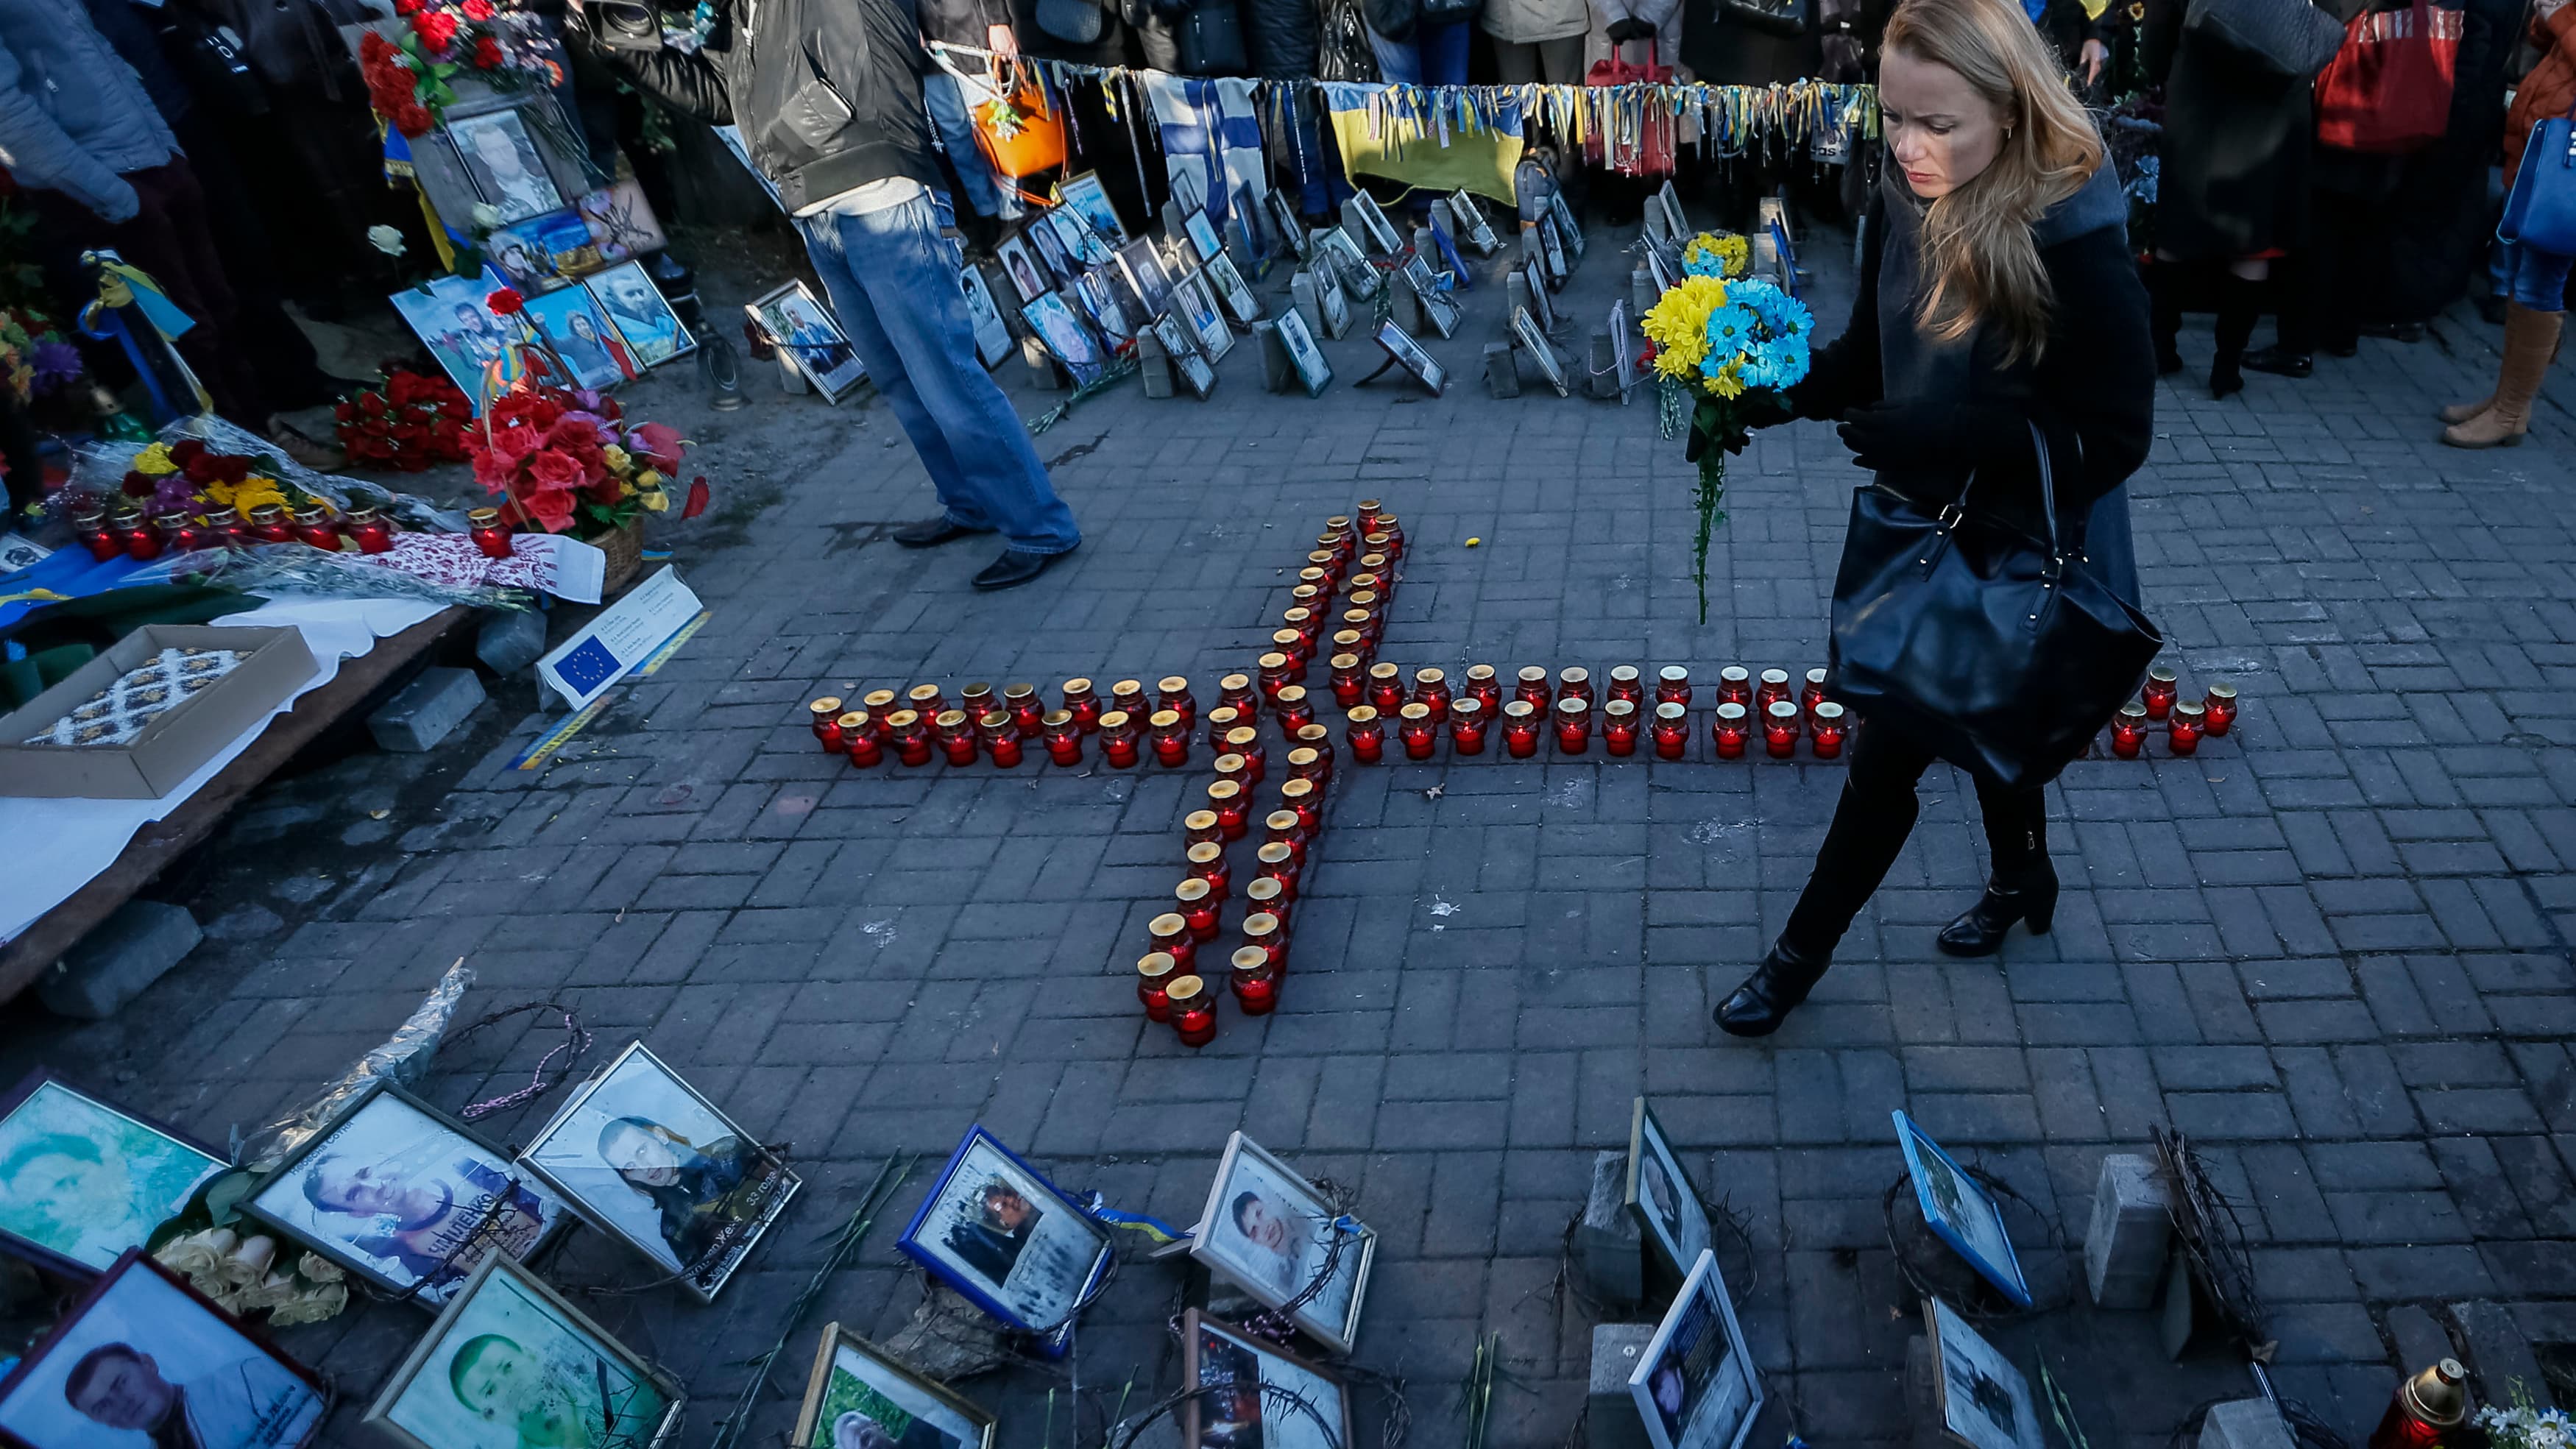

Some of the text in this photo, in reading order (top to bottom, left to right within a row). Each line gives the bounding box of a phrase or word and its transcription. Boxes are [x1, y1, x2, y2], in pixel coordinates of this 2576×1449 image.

[289, 1120, 354, 1176] Небесна Сотня
[746, 1192, 760, 1206] 33
[758, 1171, 778, 1193] года
